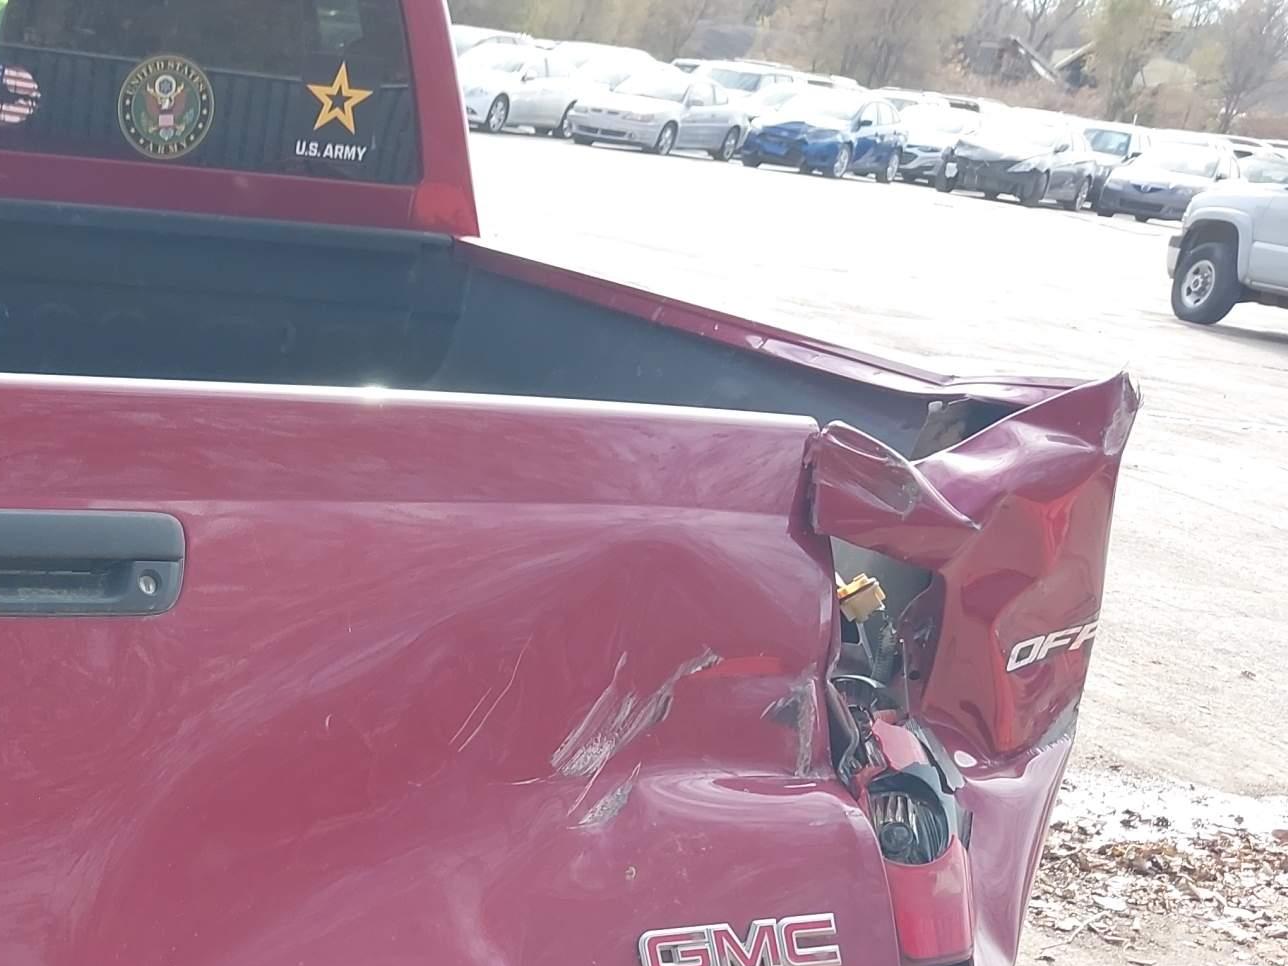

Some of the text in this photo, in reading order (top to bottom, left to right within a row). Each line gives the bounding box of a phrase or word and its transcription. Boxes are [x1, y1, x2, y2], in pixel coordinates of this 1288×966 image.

[127, 60, 205, 96] UNITED STATES
[146, 140, 189, 154] ARMY
[295, 139, 367, 161] U.S. ARMY
